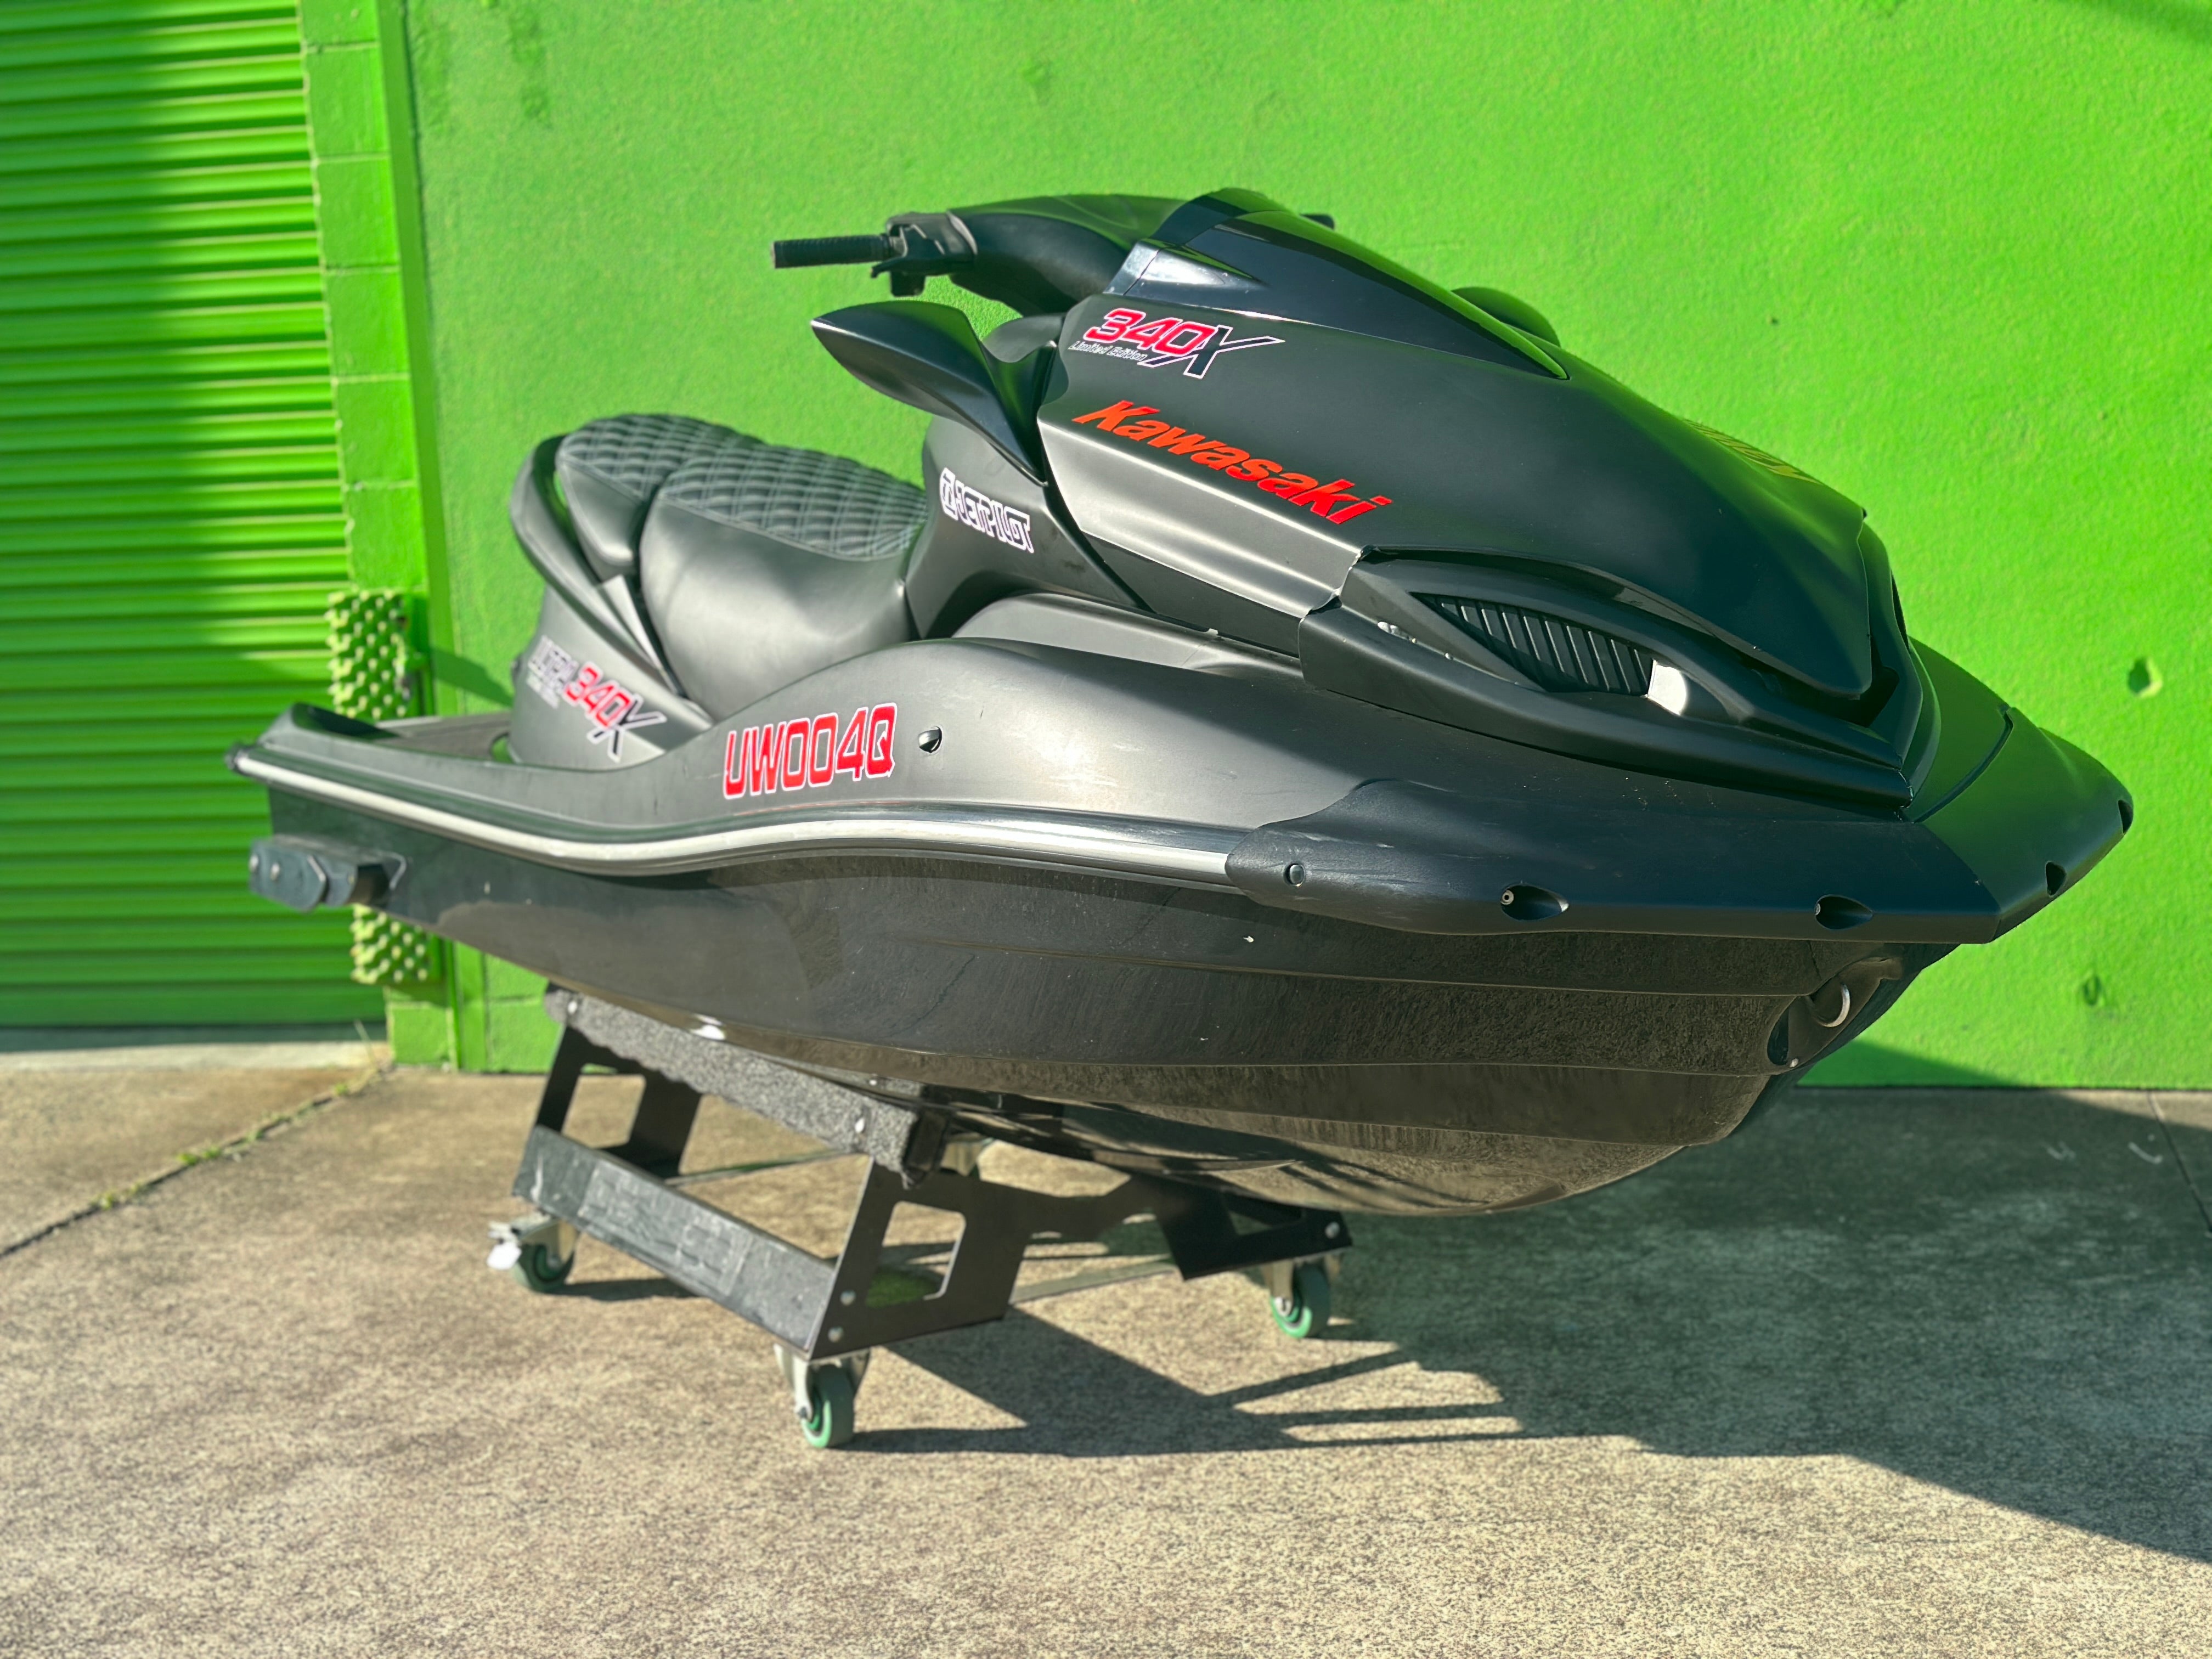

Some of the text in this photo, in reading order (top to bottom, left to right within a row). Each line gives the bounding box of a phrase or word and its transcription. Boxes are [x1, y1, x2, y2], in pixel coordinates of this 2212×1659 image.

[1083, 307, 1285, 379] 340X
[1072, 399, 1392, 524] Kawasaki
[562, 661, 668, 764] 340X
